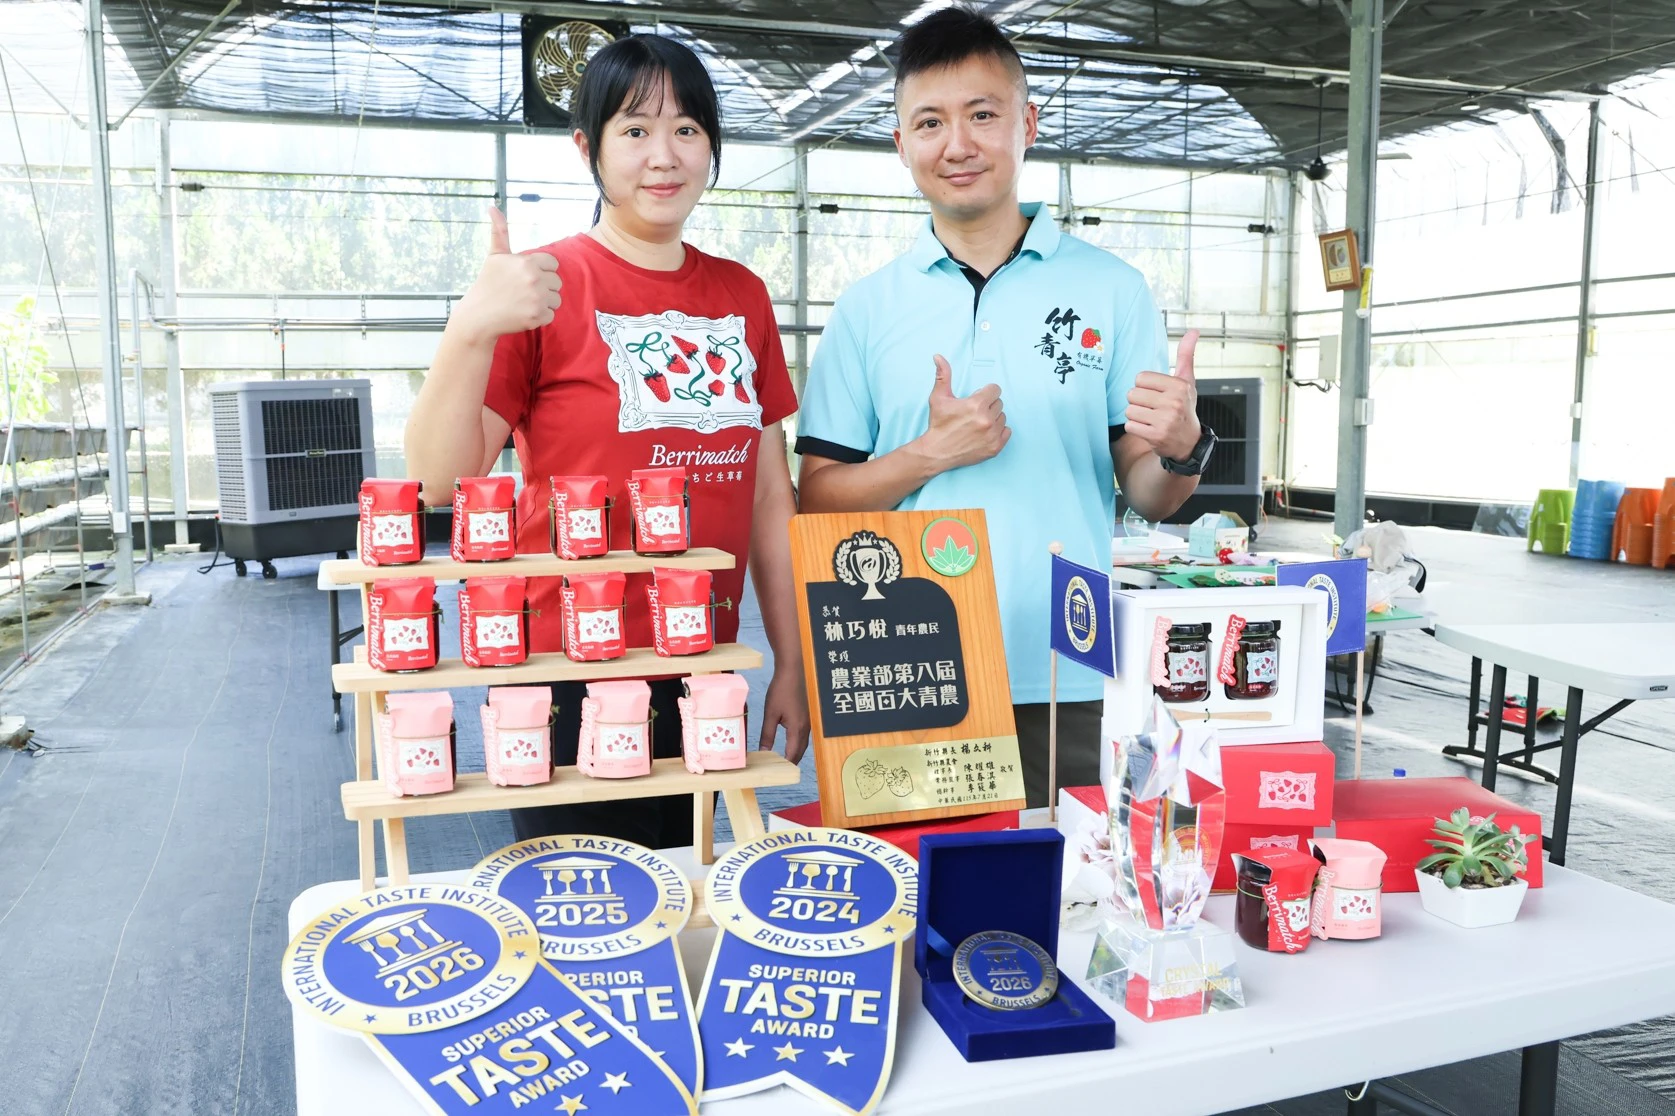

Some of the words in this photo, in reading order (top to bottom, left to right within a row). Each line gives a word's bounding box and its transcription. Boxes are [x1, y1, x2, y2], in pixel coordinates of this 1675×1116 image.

[1034, 307, 1081, 384] 竹青亭
[649, 439, 752, 466] Berrimatch
[361, 495, 378, 565] Berrimatch
[452, 492, 466, 562] Berrimatch
[555, 492, 576, 559] Berrimatch
[627, 482, 655, 545] Berrimatch
[370, 595, 386, 669] Berrimatch
[459, 595, 478, 665] Berrimatch
[562, 590, 585, 661] Berrimatch
[648, 588, 669, 656] Berrimatch
[895, 622, 940, 637] 青年農民
[831, 660, 957, 690] 農業部第八屆
[1221, 617, 1244, 684] Berrimatch
[832, 684, 960, 715] 全國百大青農
[473, 839, 564, 892] RNATIONAL
[571, 838, 635, 856] TASTE
[636, 852, 686, 913] INSTITUTE
[713, 832, 817, 902] INTERNATIONAL
[827, 832, 887, 855] TASTE
[536, 902, 629, 927] 2025
[769, 896, 860, 924] 2024
[1265, 885, 1303, 951] Berrimatch
[295, 898, 359, 1016] INTERNATIONAL
[360, 887, 431, 908] TASTE
[441, 887, 528, 938] INSTITUTE
[540, 933, 642, 955] RUSSELS
[754, 928, 865, 951] BRUSSELS
[384, 947, 485, 1002] 2026
[408, 972, 517, 1027] BRUSSELS
[564, 970, 644, 987] PERIOR
[719, 979, 882, 1025] TASTE
[748, 963, 856, 986] SUPERIOR
[990, 976, 1033, 991] 2026
[992, 994, 1041, 1007] BRUSSELS
[441, 1006, 551, 1062] SUPERIOR
[750, 1019, 835, 1039] AWARD
[429, 1009, 611, 1107] TASTE
[508, 1059, 591, 1109] AWARD
